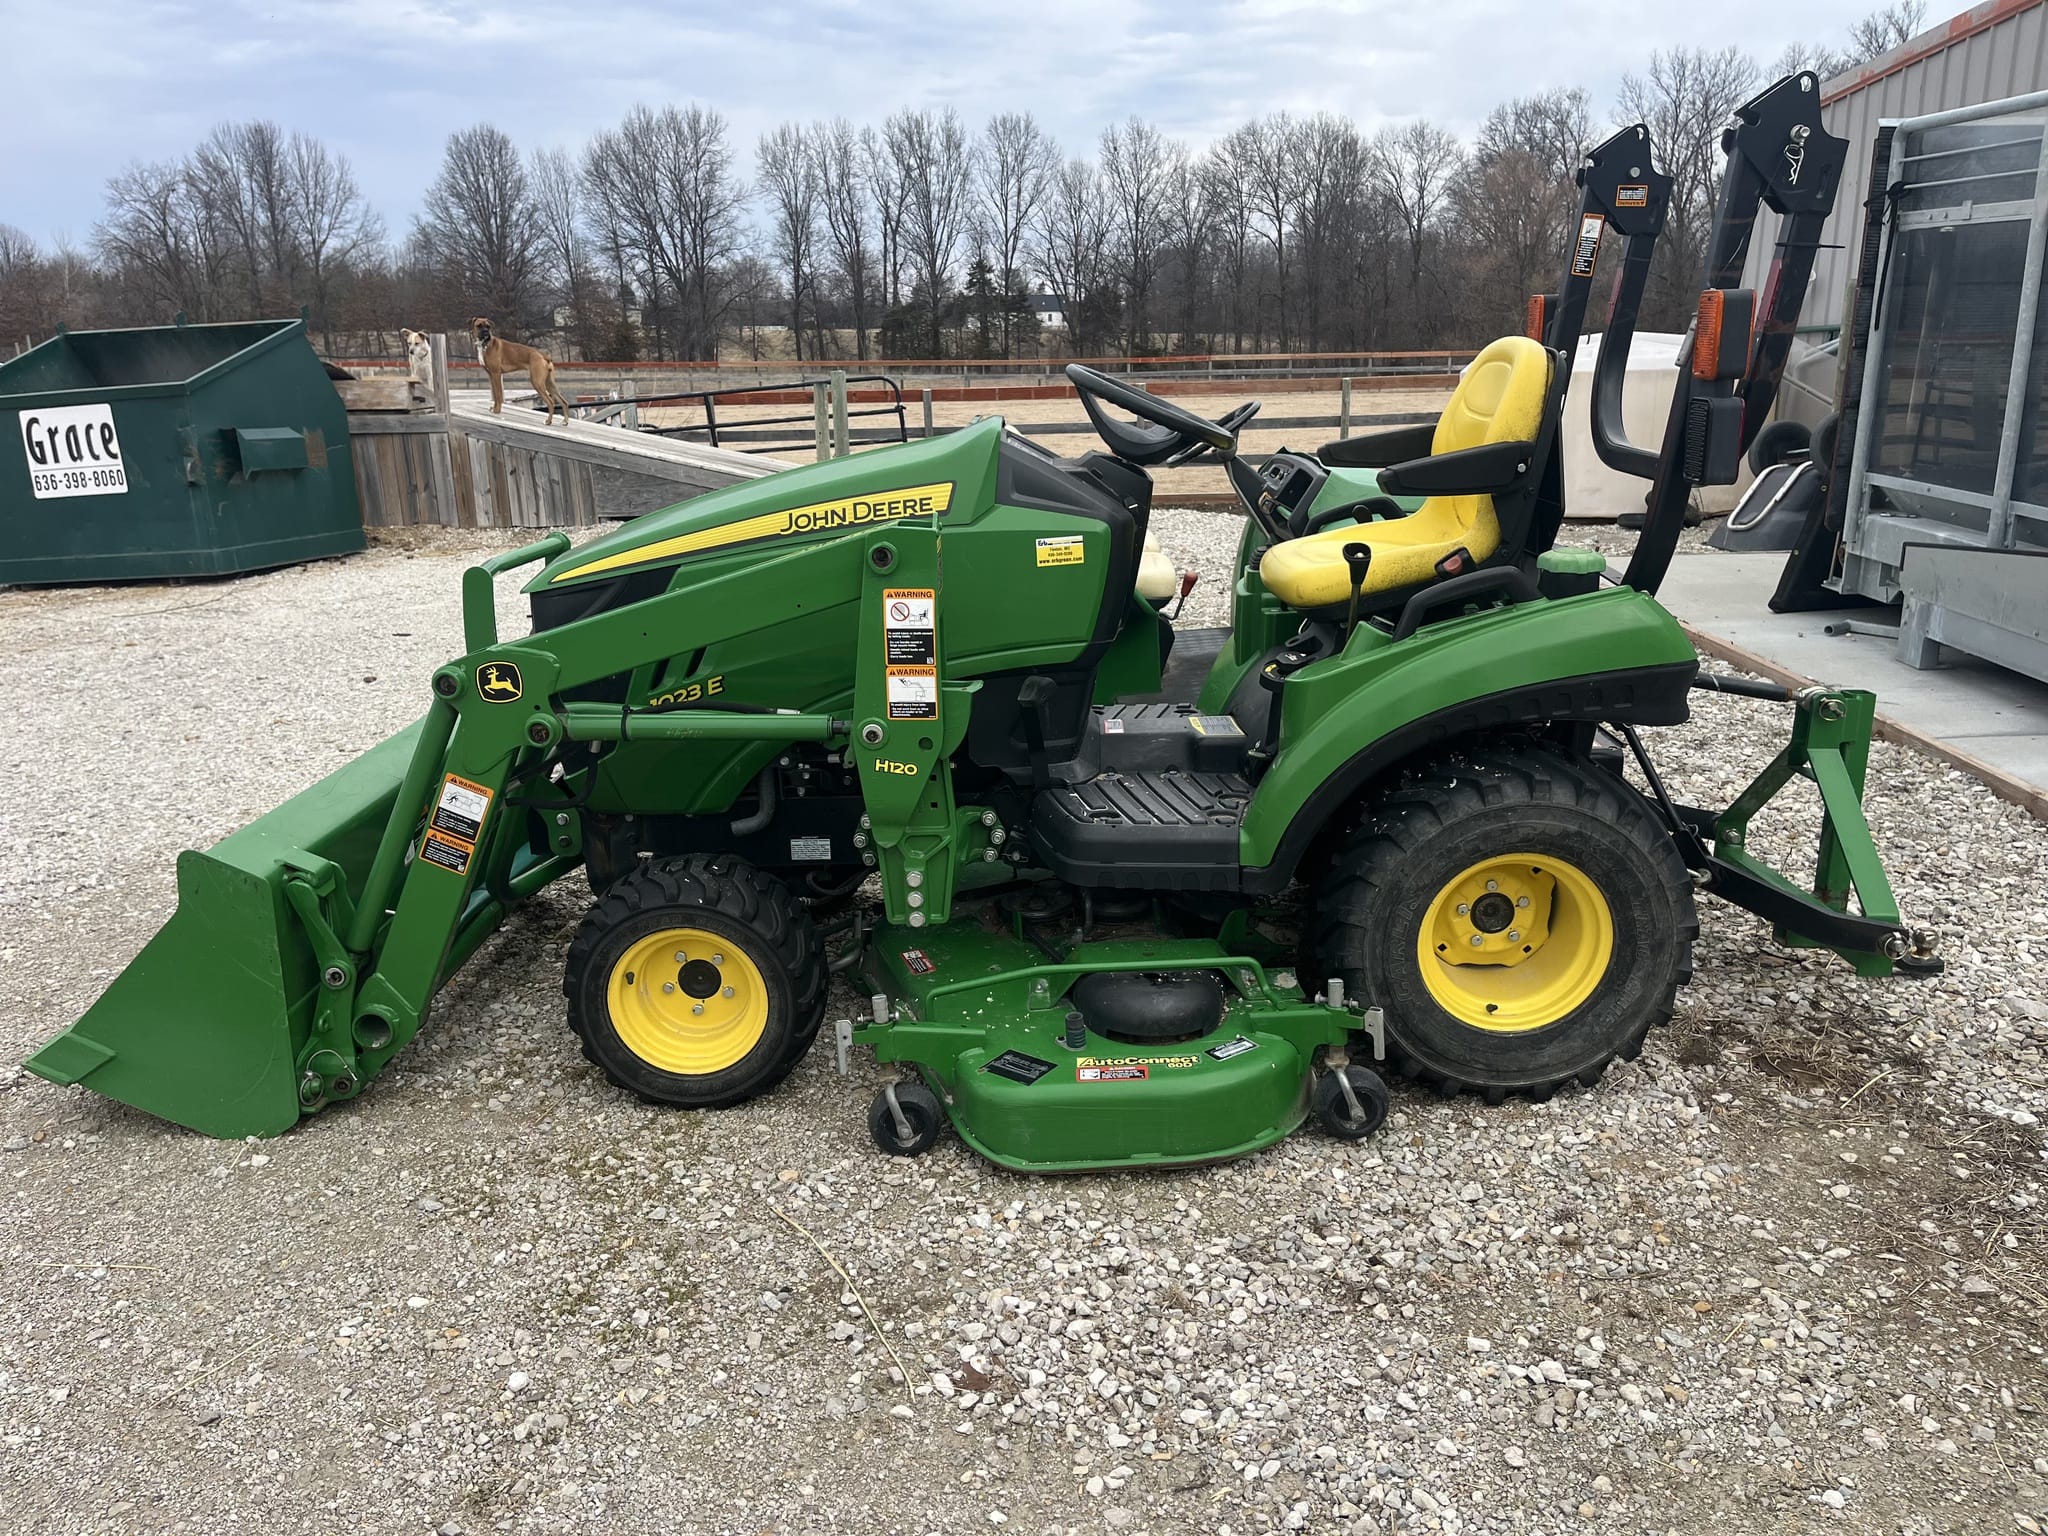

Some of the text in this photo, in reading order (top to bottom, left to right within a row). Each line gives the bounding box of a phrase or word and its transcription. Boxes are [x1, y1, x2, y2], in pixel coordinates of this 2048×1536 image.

[26, 416, 119, 465] Grace
[34, 469, 124, 491] 636-398-8060
[780, 497, 933, 533] JOHN DEERE
[875, 758, 918, 776] H120
[458, 779, 488, 796] WARNING
[440, 837, 469, 851] WARNING
[1078, 1055, 1200, 1067] AutoConnect
